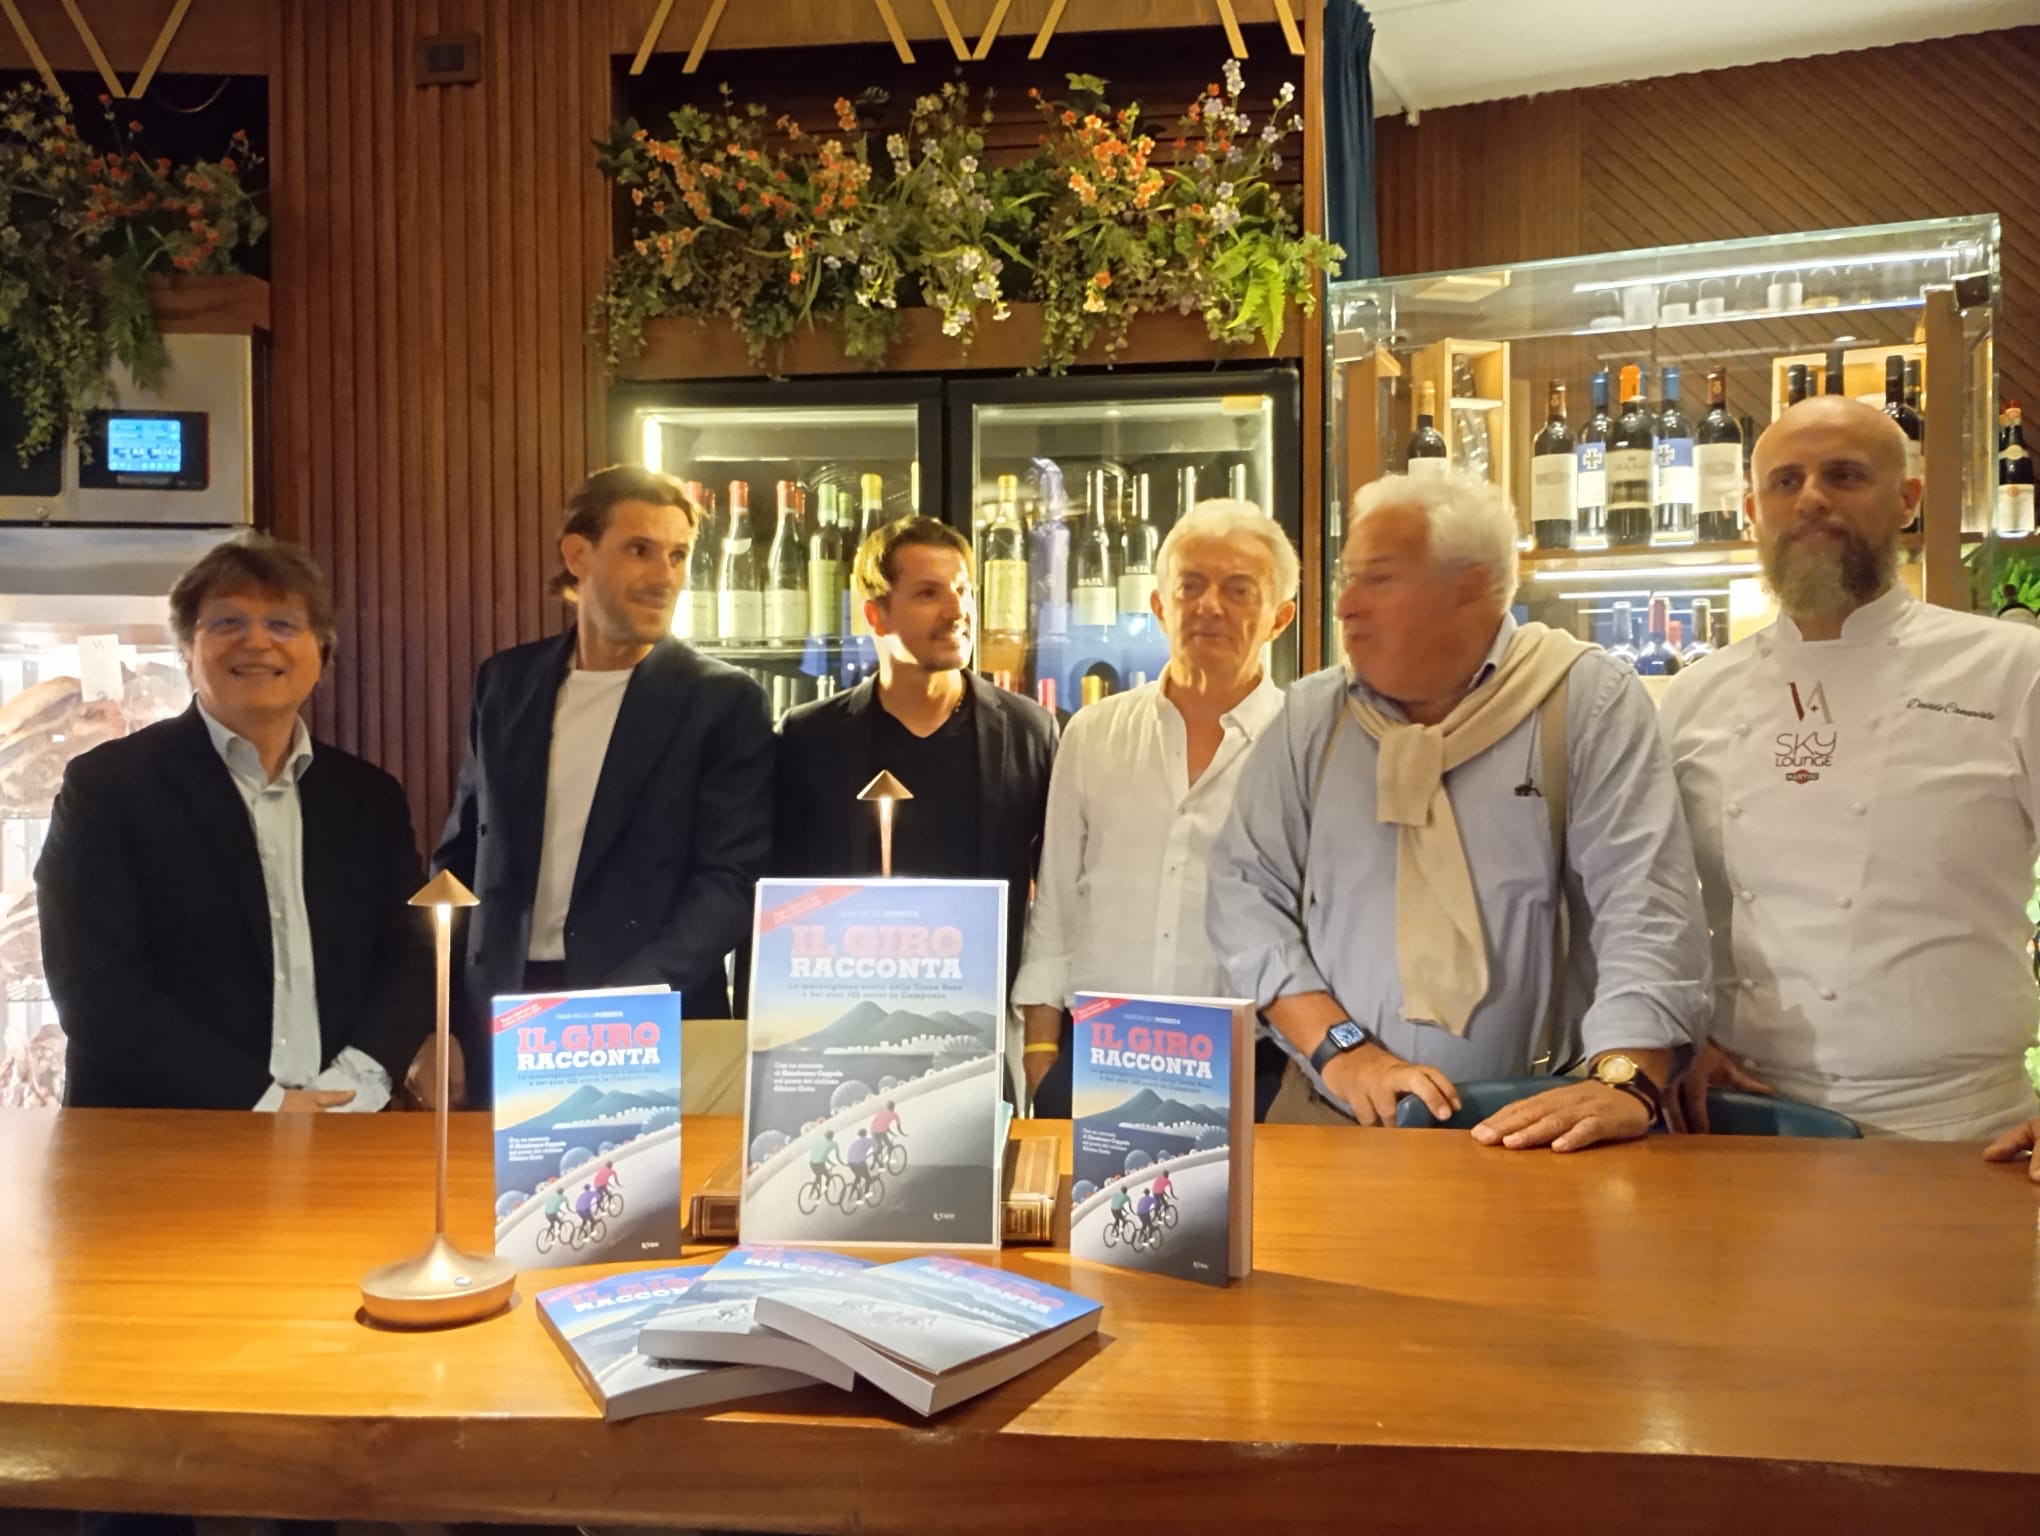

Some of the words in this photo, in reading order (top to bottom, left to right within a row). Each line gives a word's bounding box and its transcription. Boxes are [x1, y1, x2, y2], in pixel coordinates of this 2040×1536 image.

[1775, 731, 1837, 756] SKY
[1775, 756, 1832, 767] LOUNGE
[791, 925, 837, 957] IL
[844, 924, 964, 958] GIRO
[790, 957, 963, 979] RACCONTA
[517, 1027, 556, 1053] IL
[561, 1021, 661, 1051] GIRO
[1091, 1022, 1123, 1049] IL
[1127, 1026, 1213, 1060] GIRO
[516, 1047, 661, 1072] RACCONTA
[1090, 1047, 1213, 1079] RACCONTA
